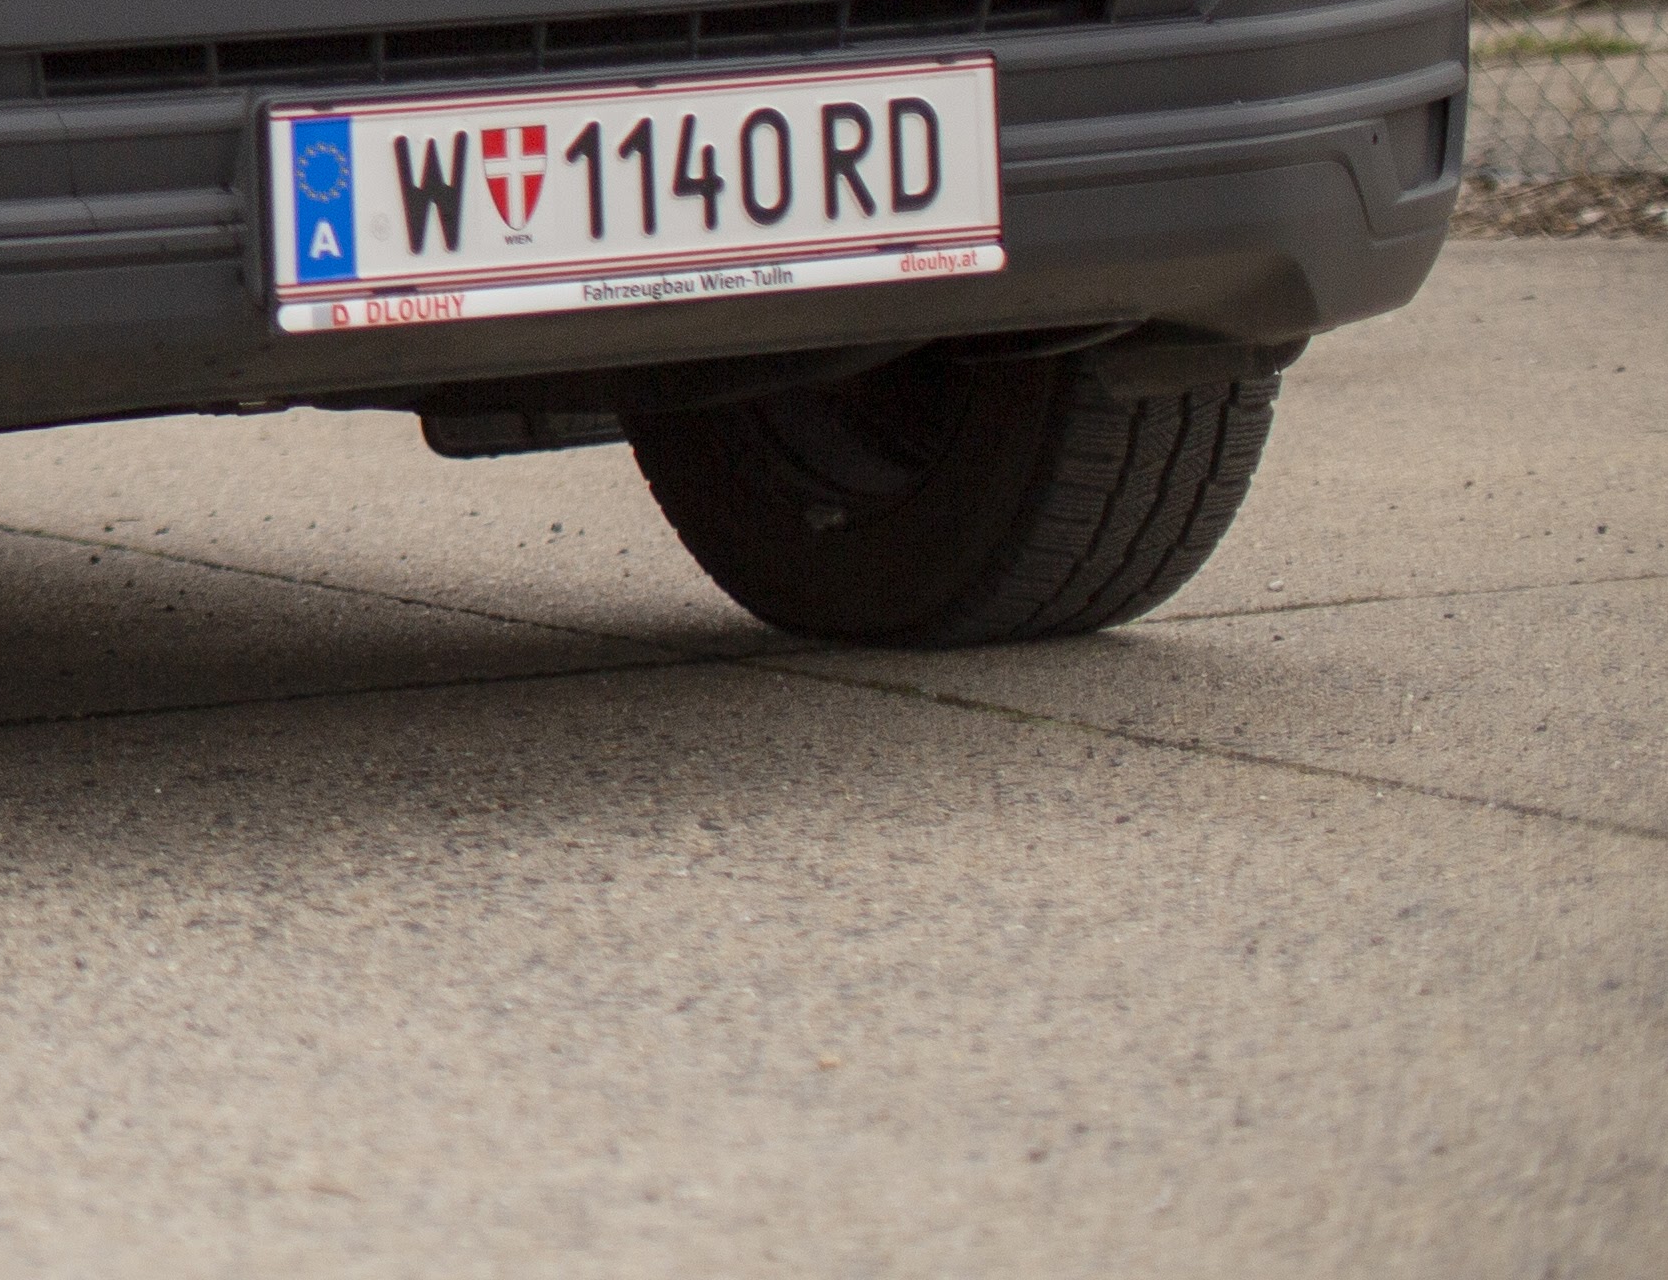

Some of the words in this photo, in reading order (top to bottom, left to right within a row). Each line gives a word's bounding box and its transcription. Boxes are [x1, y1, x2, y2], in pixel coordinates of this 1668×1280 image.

[392, 128, 469, 257] W
[308, 219, 343, 261] A
[503, 232, 534, 246] WIEN
[366, 293, 468, 326] DLOUHY
[581, 275, 696, 304] Fahrzeugbau
[699, 266, 795, 294] Wien-Tulln
[899, 249, 980, 274] dlouhy.at
